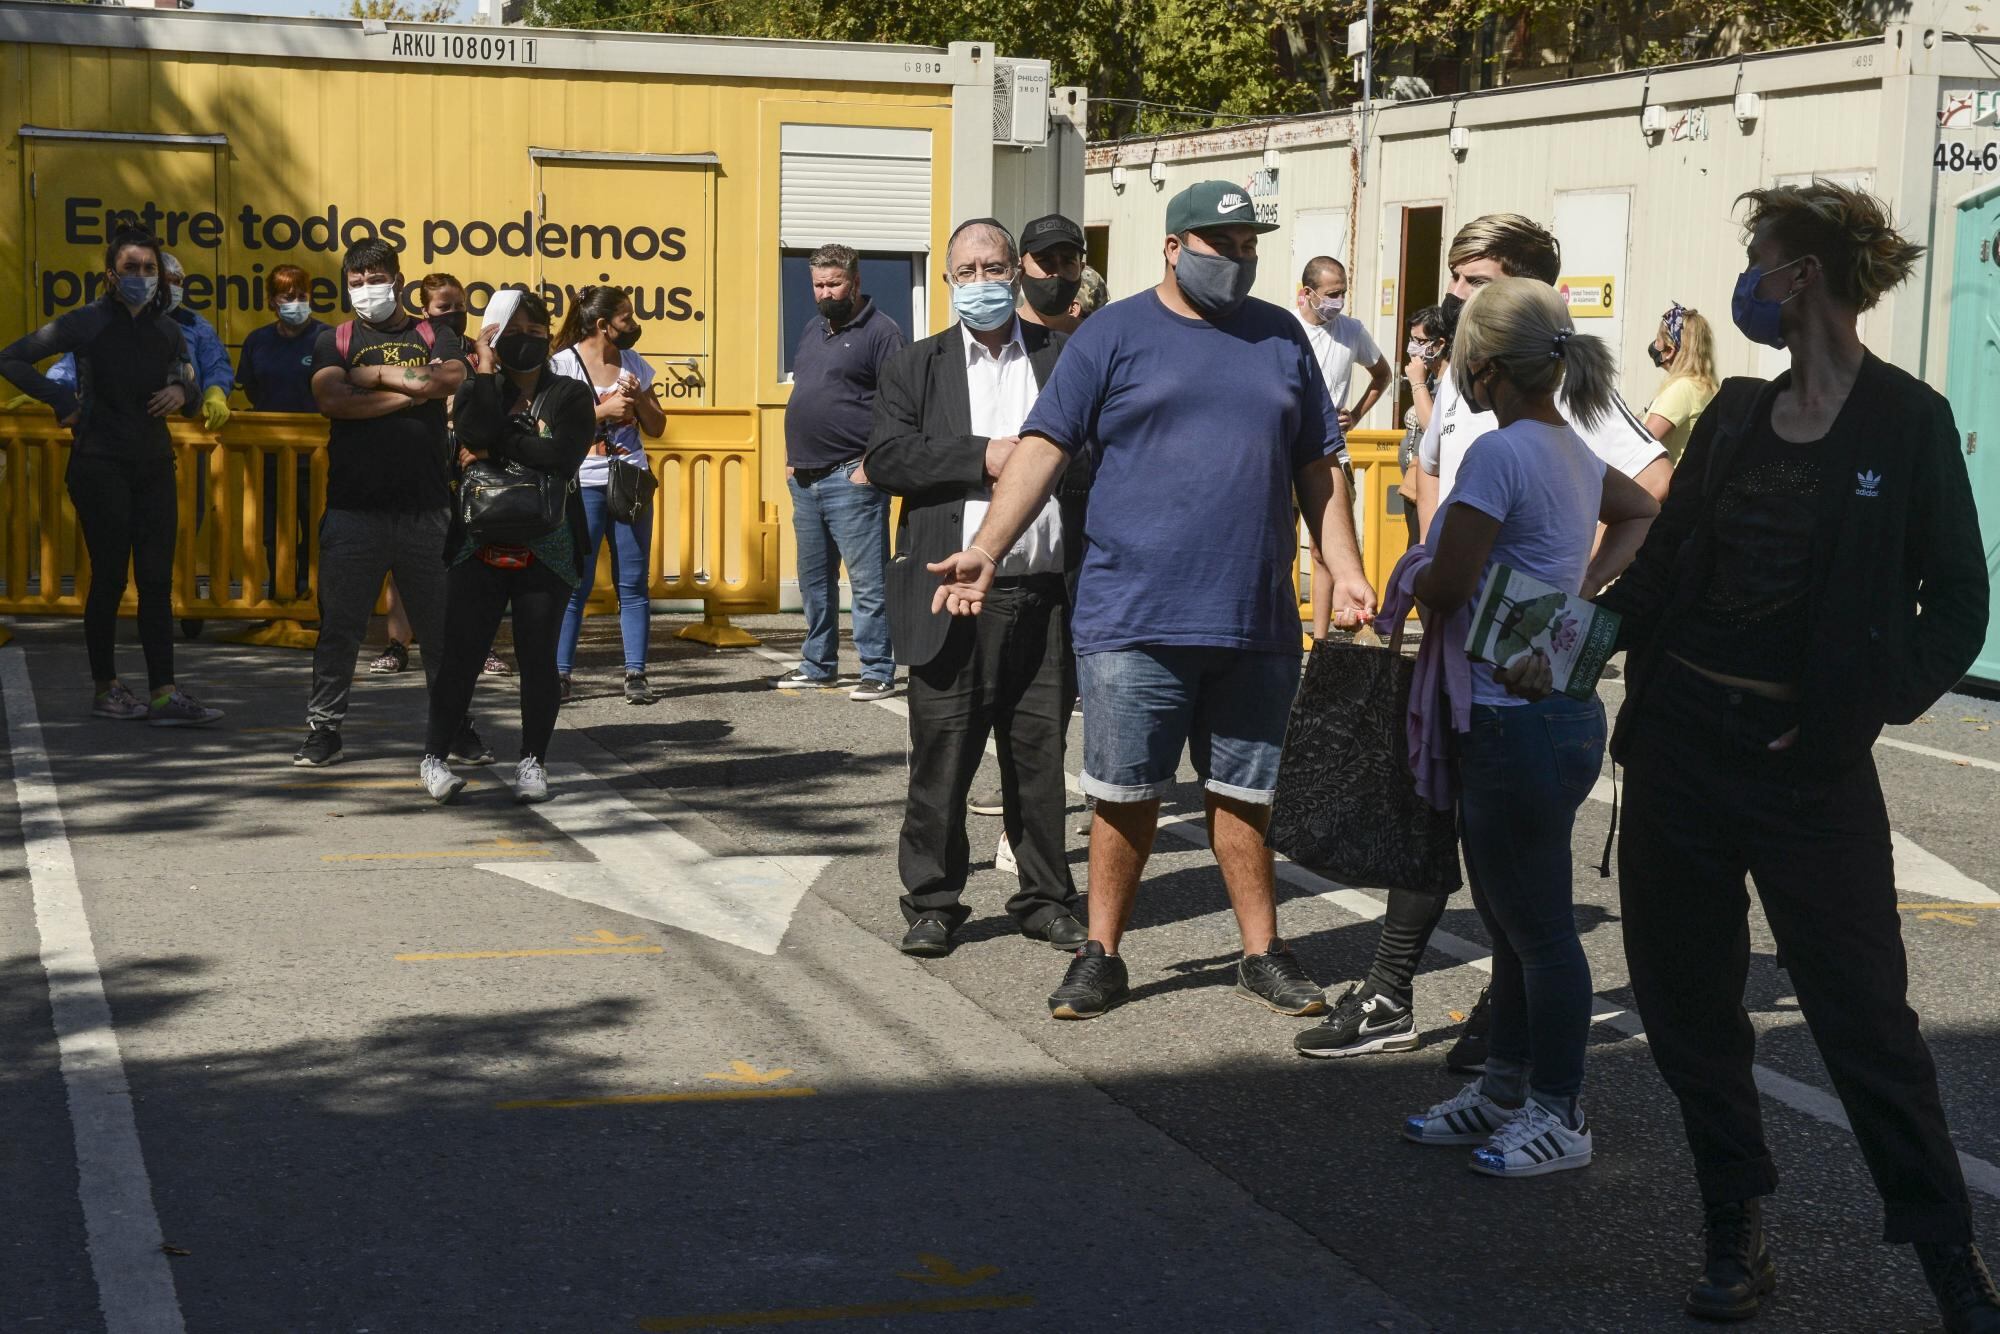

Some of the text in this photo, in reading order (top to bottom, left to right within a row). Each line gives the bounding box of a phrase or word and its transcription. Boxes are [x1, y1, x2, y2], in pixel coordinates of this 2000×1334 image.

[392, 32, 435, 58] ARKU
[442, 35, 515, 61] 108091
[1222, 193, 1242, 206] NIKE
[65, 198, 687, 264] Entre todos podemos
[1603, 283, 1612, 308] 8
